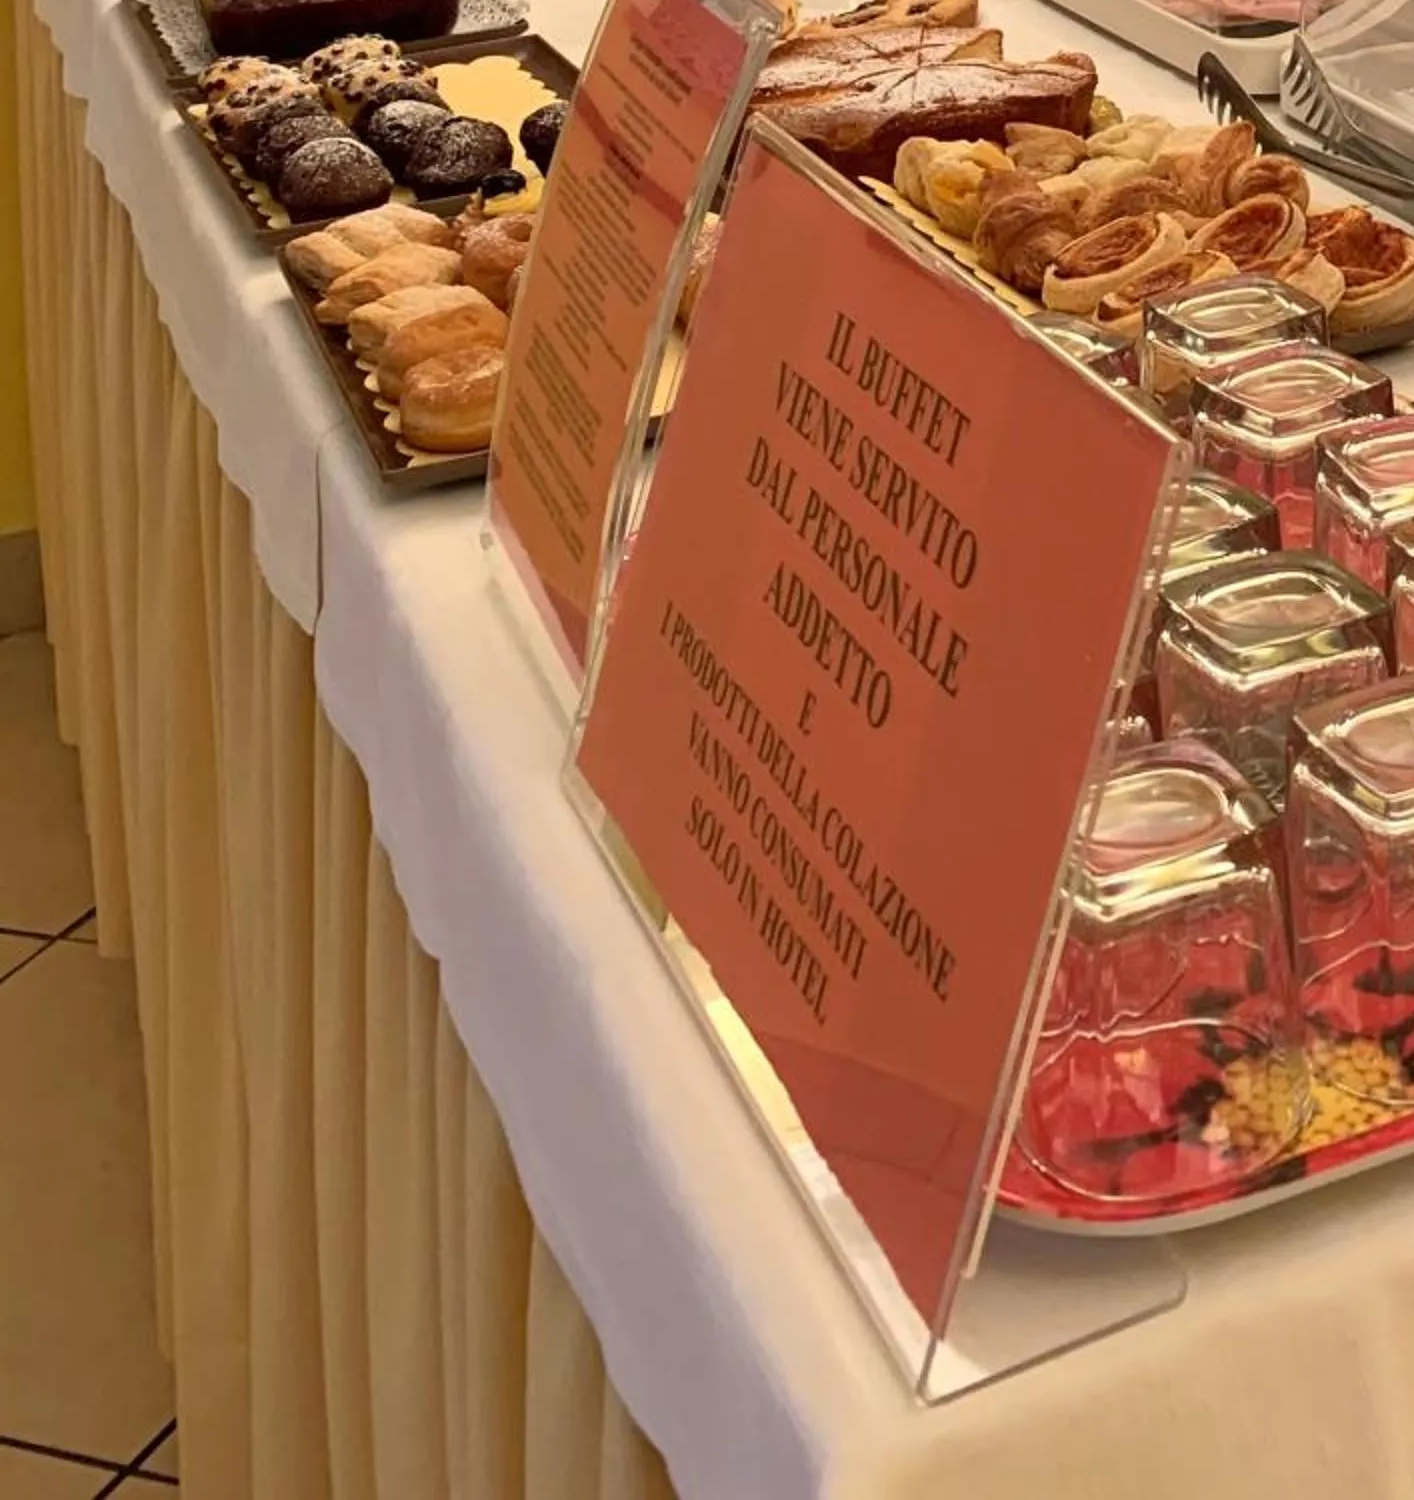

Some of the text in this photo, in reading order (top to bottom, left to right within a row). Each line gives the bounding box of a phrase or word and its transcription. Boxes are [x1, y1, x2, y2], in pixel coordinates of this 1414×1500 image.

[776, 361, 977, 589] VIENE SERVITO
[826, 312, 971, 468] IL BUFFET
[746, 436, 968, 698] DAL PERSONALE
[763, 561, 892, 728] ADDETTO
[660, 601, 956, 1002] I PRODOTTI DELLA COLAZIONE
[797, 689, 817, 736] E
[685, 796, 829, 1027] SOLO IN HOTEL
[689, 711, 868, 981] VANNO CONSUMATI
